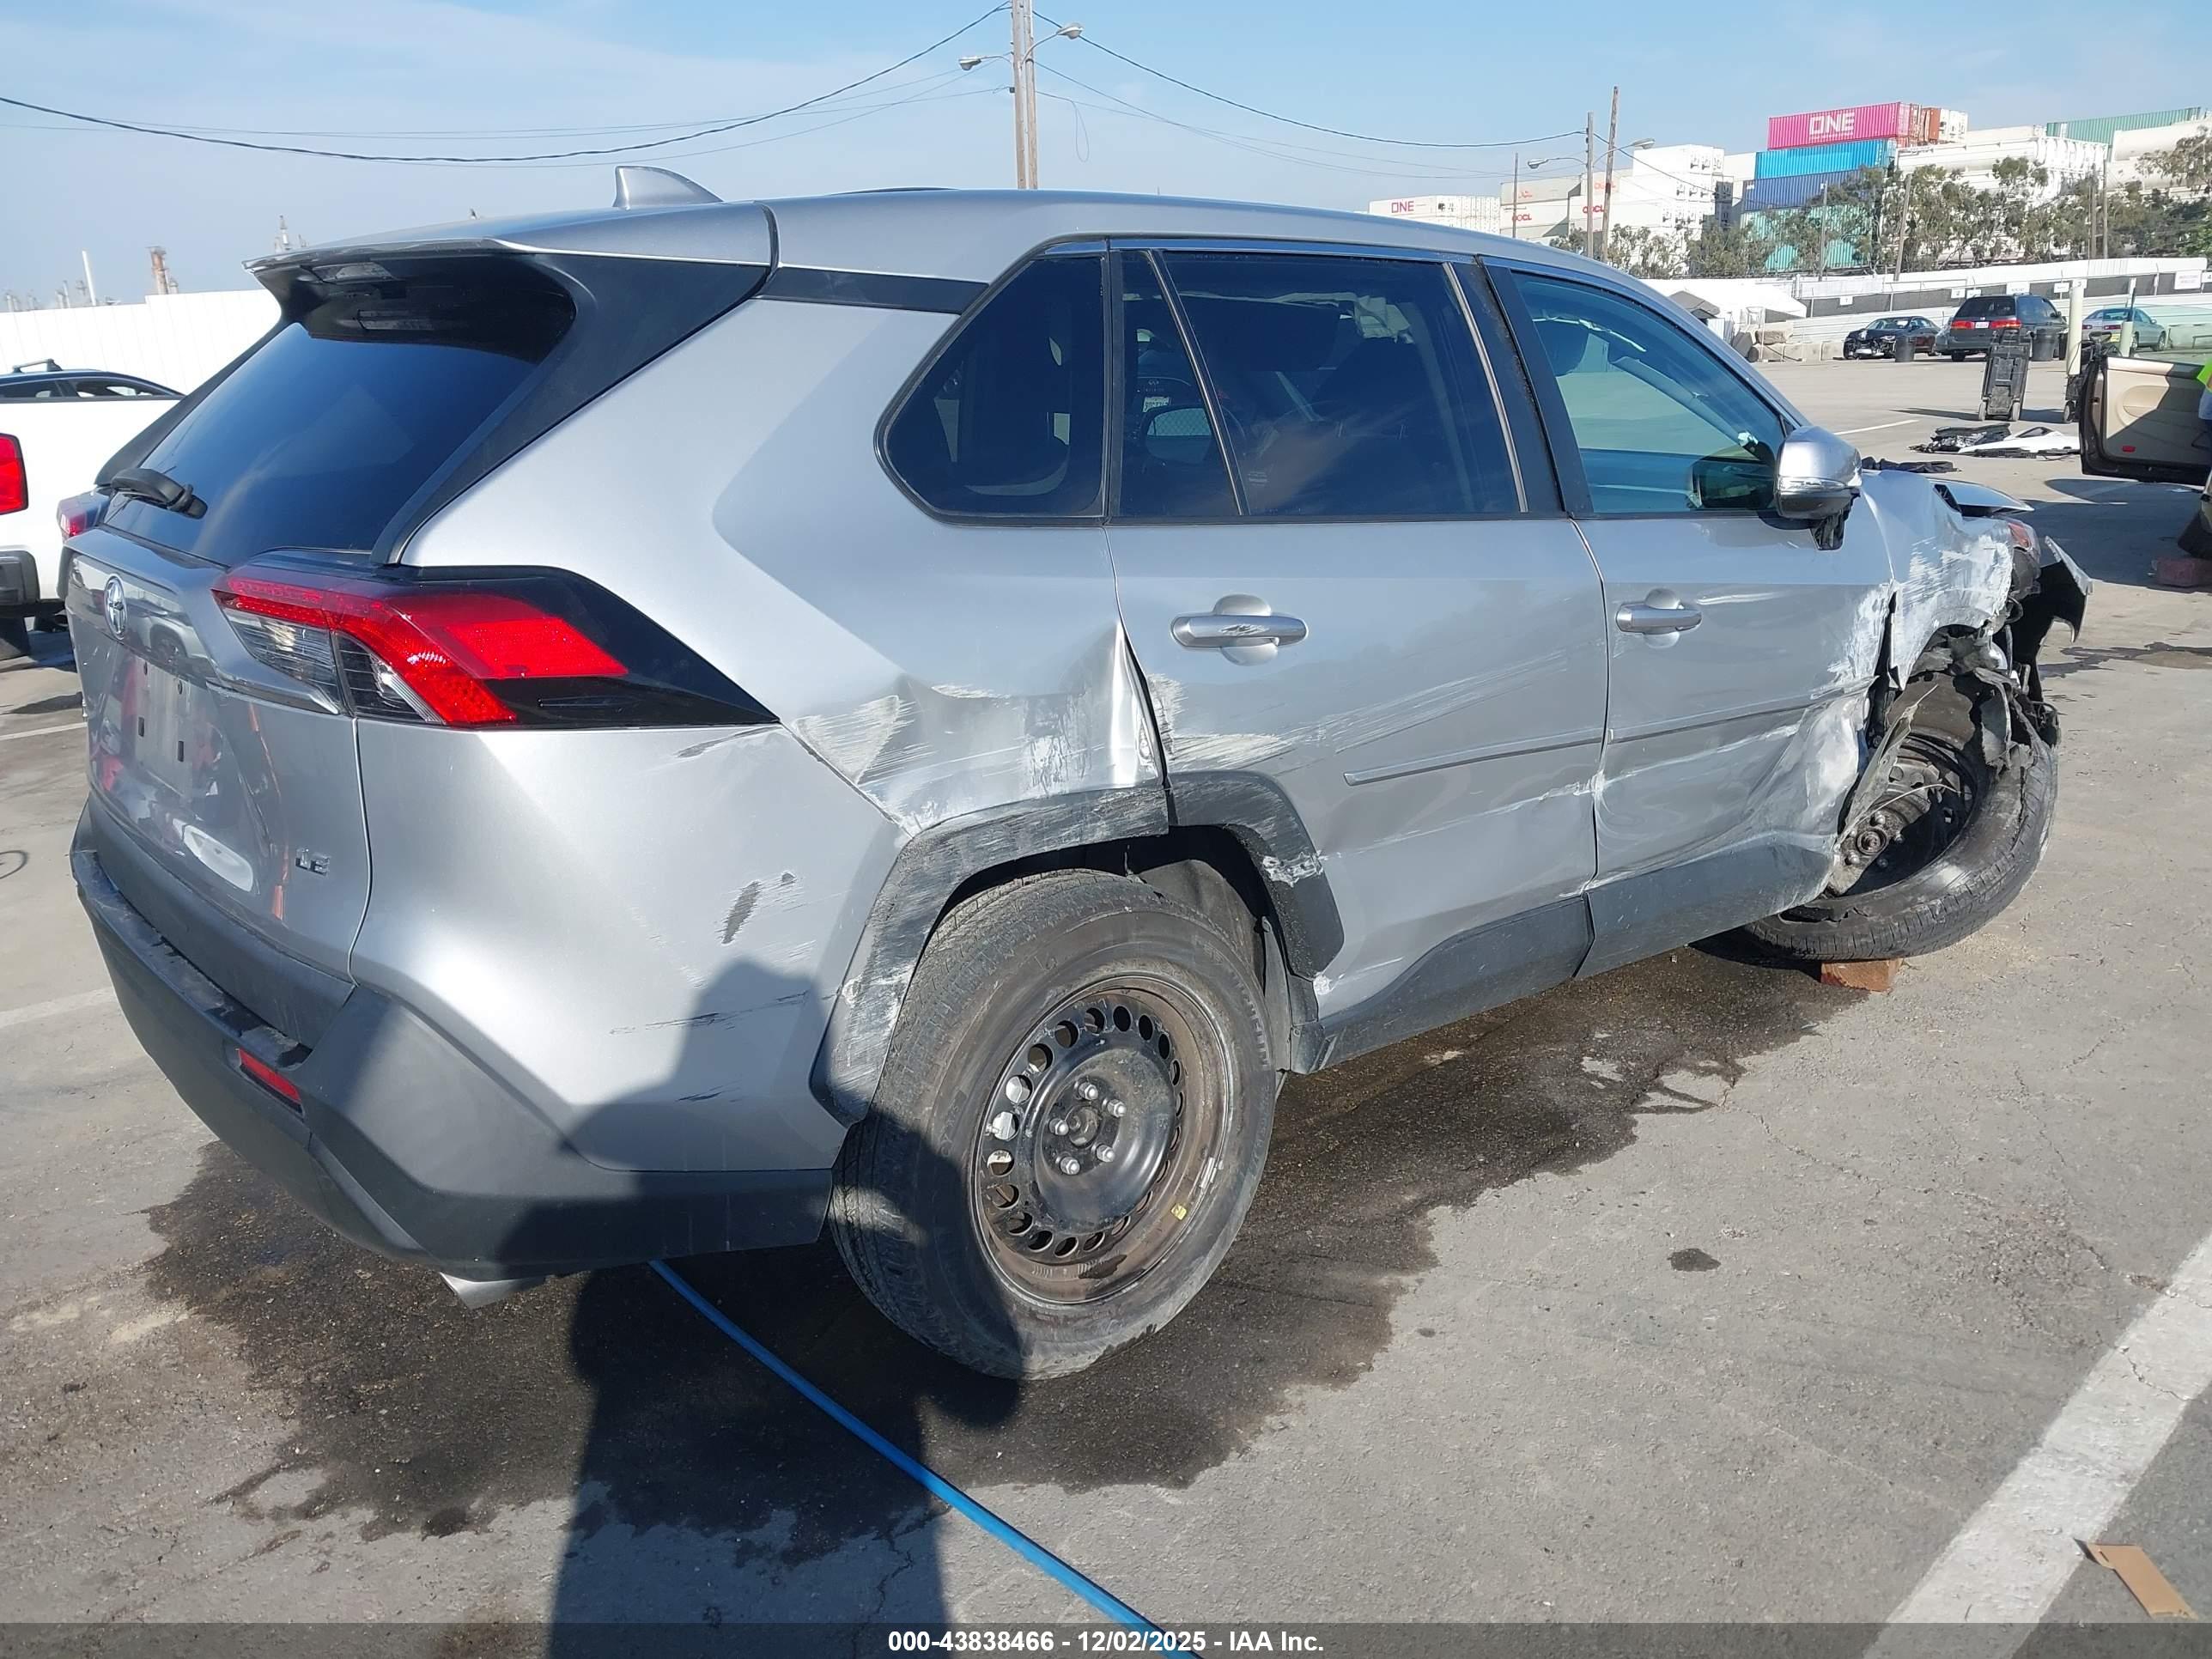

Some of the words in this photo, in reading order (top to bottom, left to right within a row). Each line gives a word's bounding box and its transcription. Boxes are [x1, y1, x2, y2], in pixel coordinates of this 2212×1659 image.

[1809, 112, 1855, 135] ONE
[1391, 200, 1414, 213] ONE
[295, 846, 331, 878] LE
